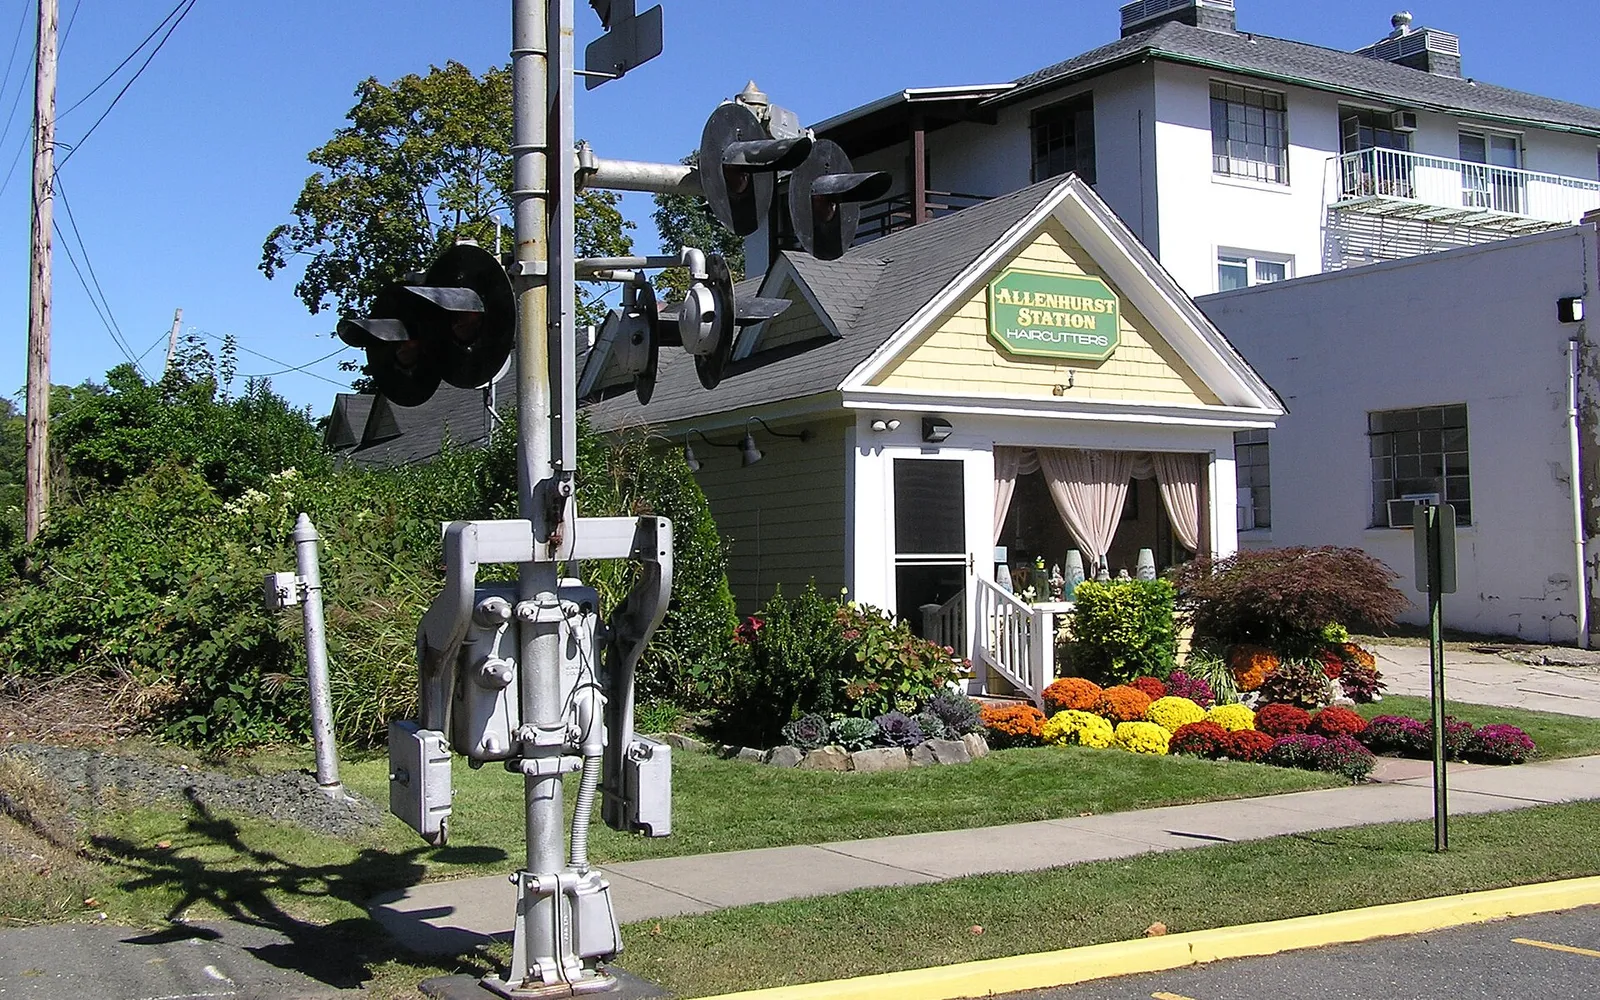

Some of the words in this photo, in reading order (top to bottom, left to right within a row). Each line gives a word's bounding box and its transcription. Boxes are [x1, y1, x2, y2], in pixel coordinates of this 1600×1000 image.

[995, 287, 1115, 314] ALLENHURST
[1017, 307, 1096, 330] STATION
[1006, 328, 1109, 347] HAIRCUTTERS
